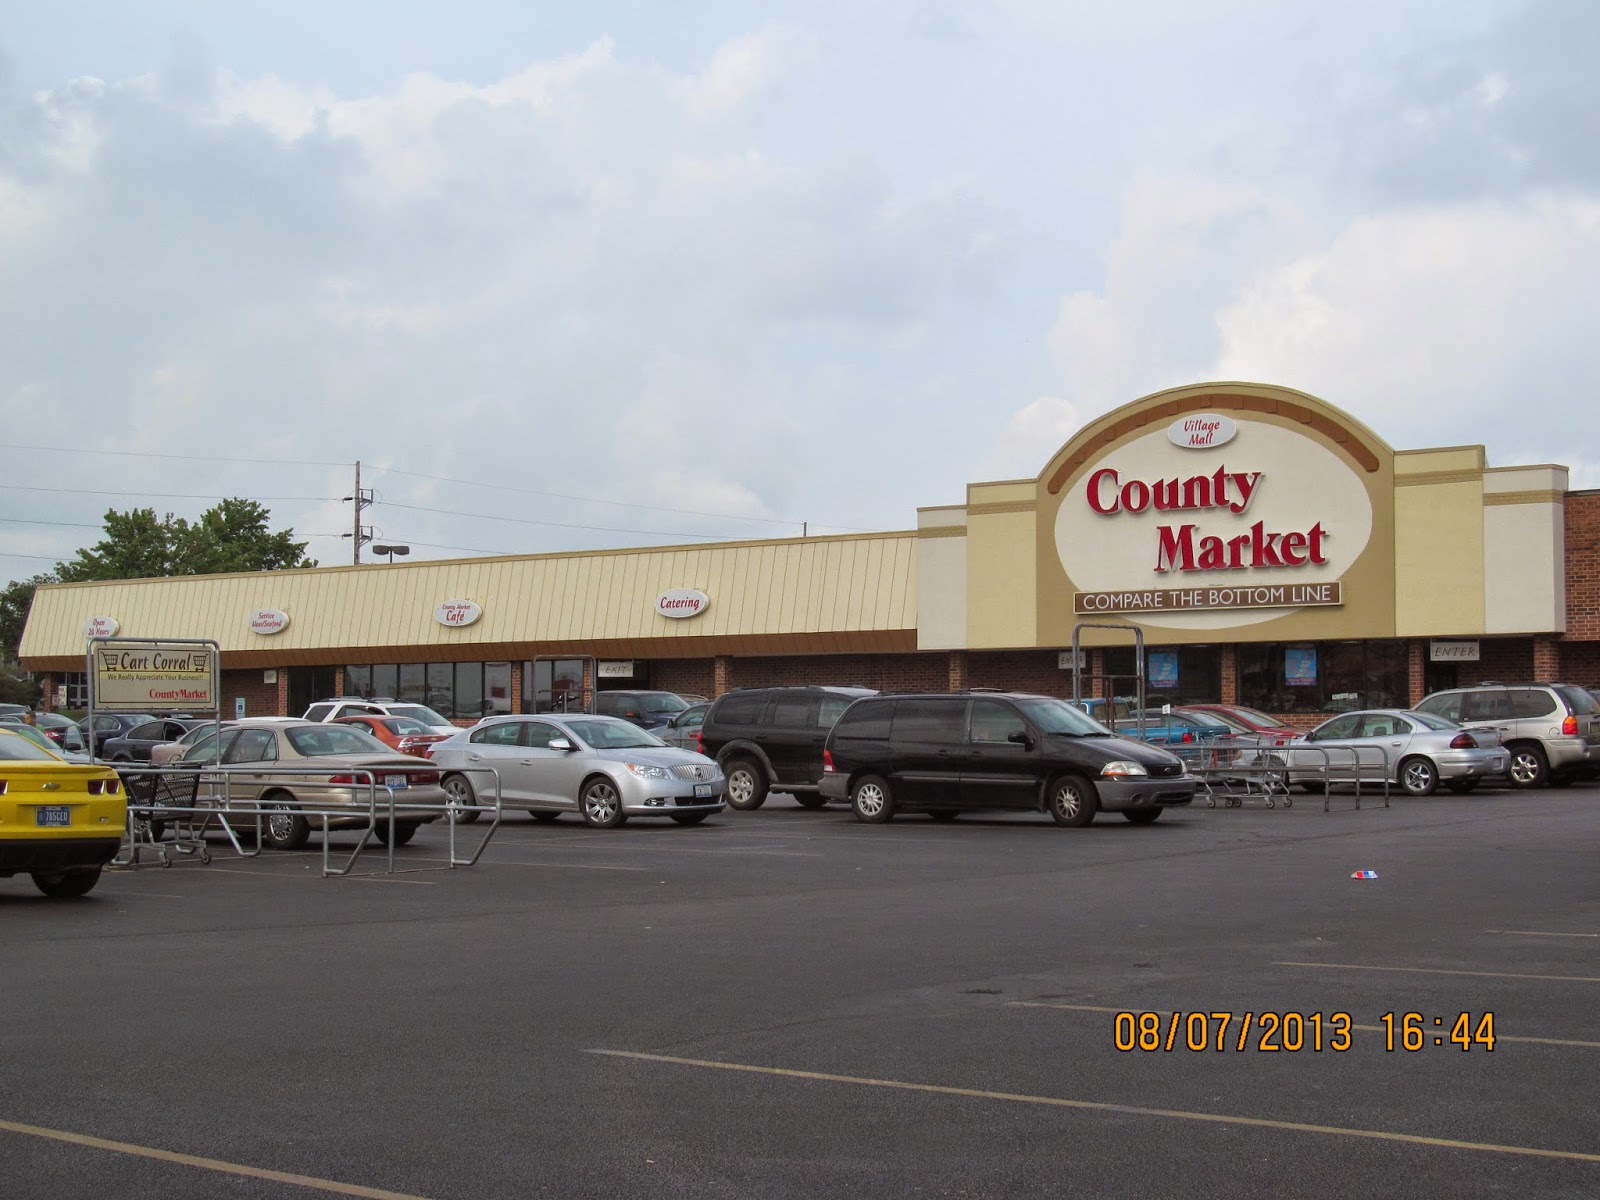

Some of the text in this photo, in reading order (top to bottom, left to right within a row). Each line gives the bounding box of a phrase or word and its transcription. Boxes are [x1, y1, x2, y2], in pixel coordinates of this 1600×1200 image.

[1184, 419, 1220, 432] Village
[1188, 432, 1213, 445] Mall
[1086, 464, 1262, 515] County
[1153, 520, 1327, 572] Market
[660, 596, 700, 610] Catering
[1083, 585, 1331, 609] COMPARE THE BOTTOM LINE
[92, 618, 106, 627] Open
[446, 610, 465, 624] Café
[1434, 646, 1476, 657] ENTER
[121, 652, 191, 671] Cart Corral
[605, 665, 628, 674] EXIT
[118, 673, 134, 682] Really
[136, 673, 164, 682] Appreciate
